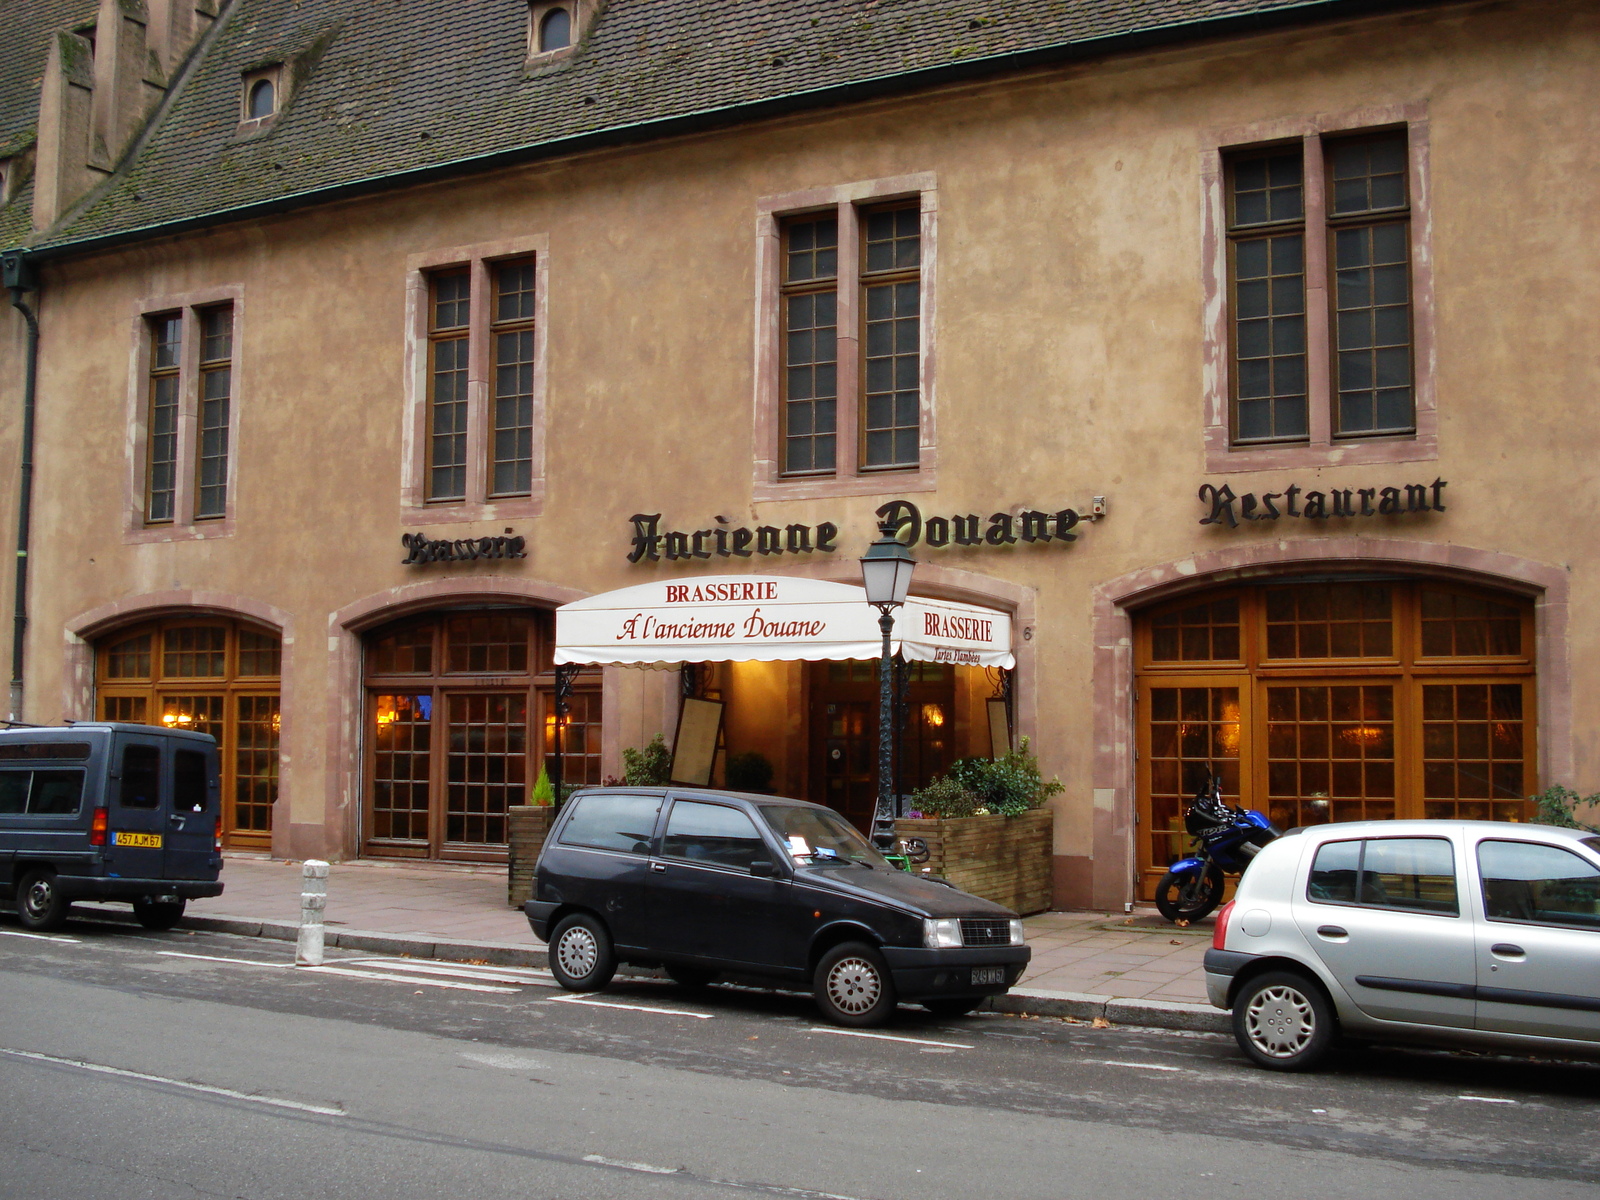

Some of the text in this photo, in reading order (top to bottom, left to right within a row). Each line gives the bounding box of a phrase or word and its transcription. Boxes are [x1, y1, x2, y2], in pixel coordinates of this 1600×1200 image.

[1198, 476, 1448, 528] Restaurant
[401, 527, 528, 564] Brasserie
[626, 499, 1080, 563] Ancienne Douane
[665, 582, 778, 603] BRASSERIE
[642, 615, 735, 639] l'ancienne
[743, 608, 826, 638] Douane
[923, 612, 993, 642] BRASSERIE
[1023, 626, 1033, 641] 6
[934, 647, 952, 661] Tartes
[117, 834, 132, 845] 457
[150, 836, 160, 847] 67
